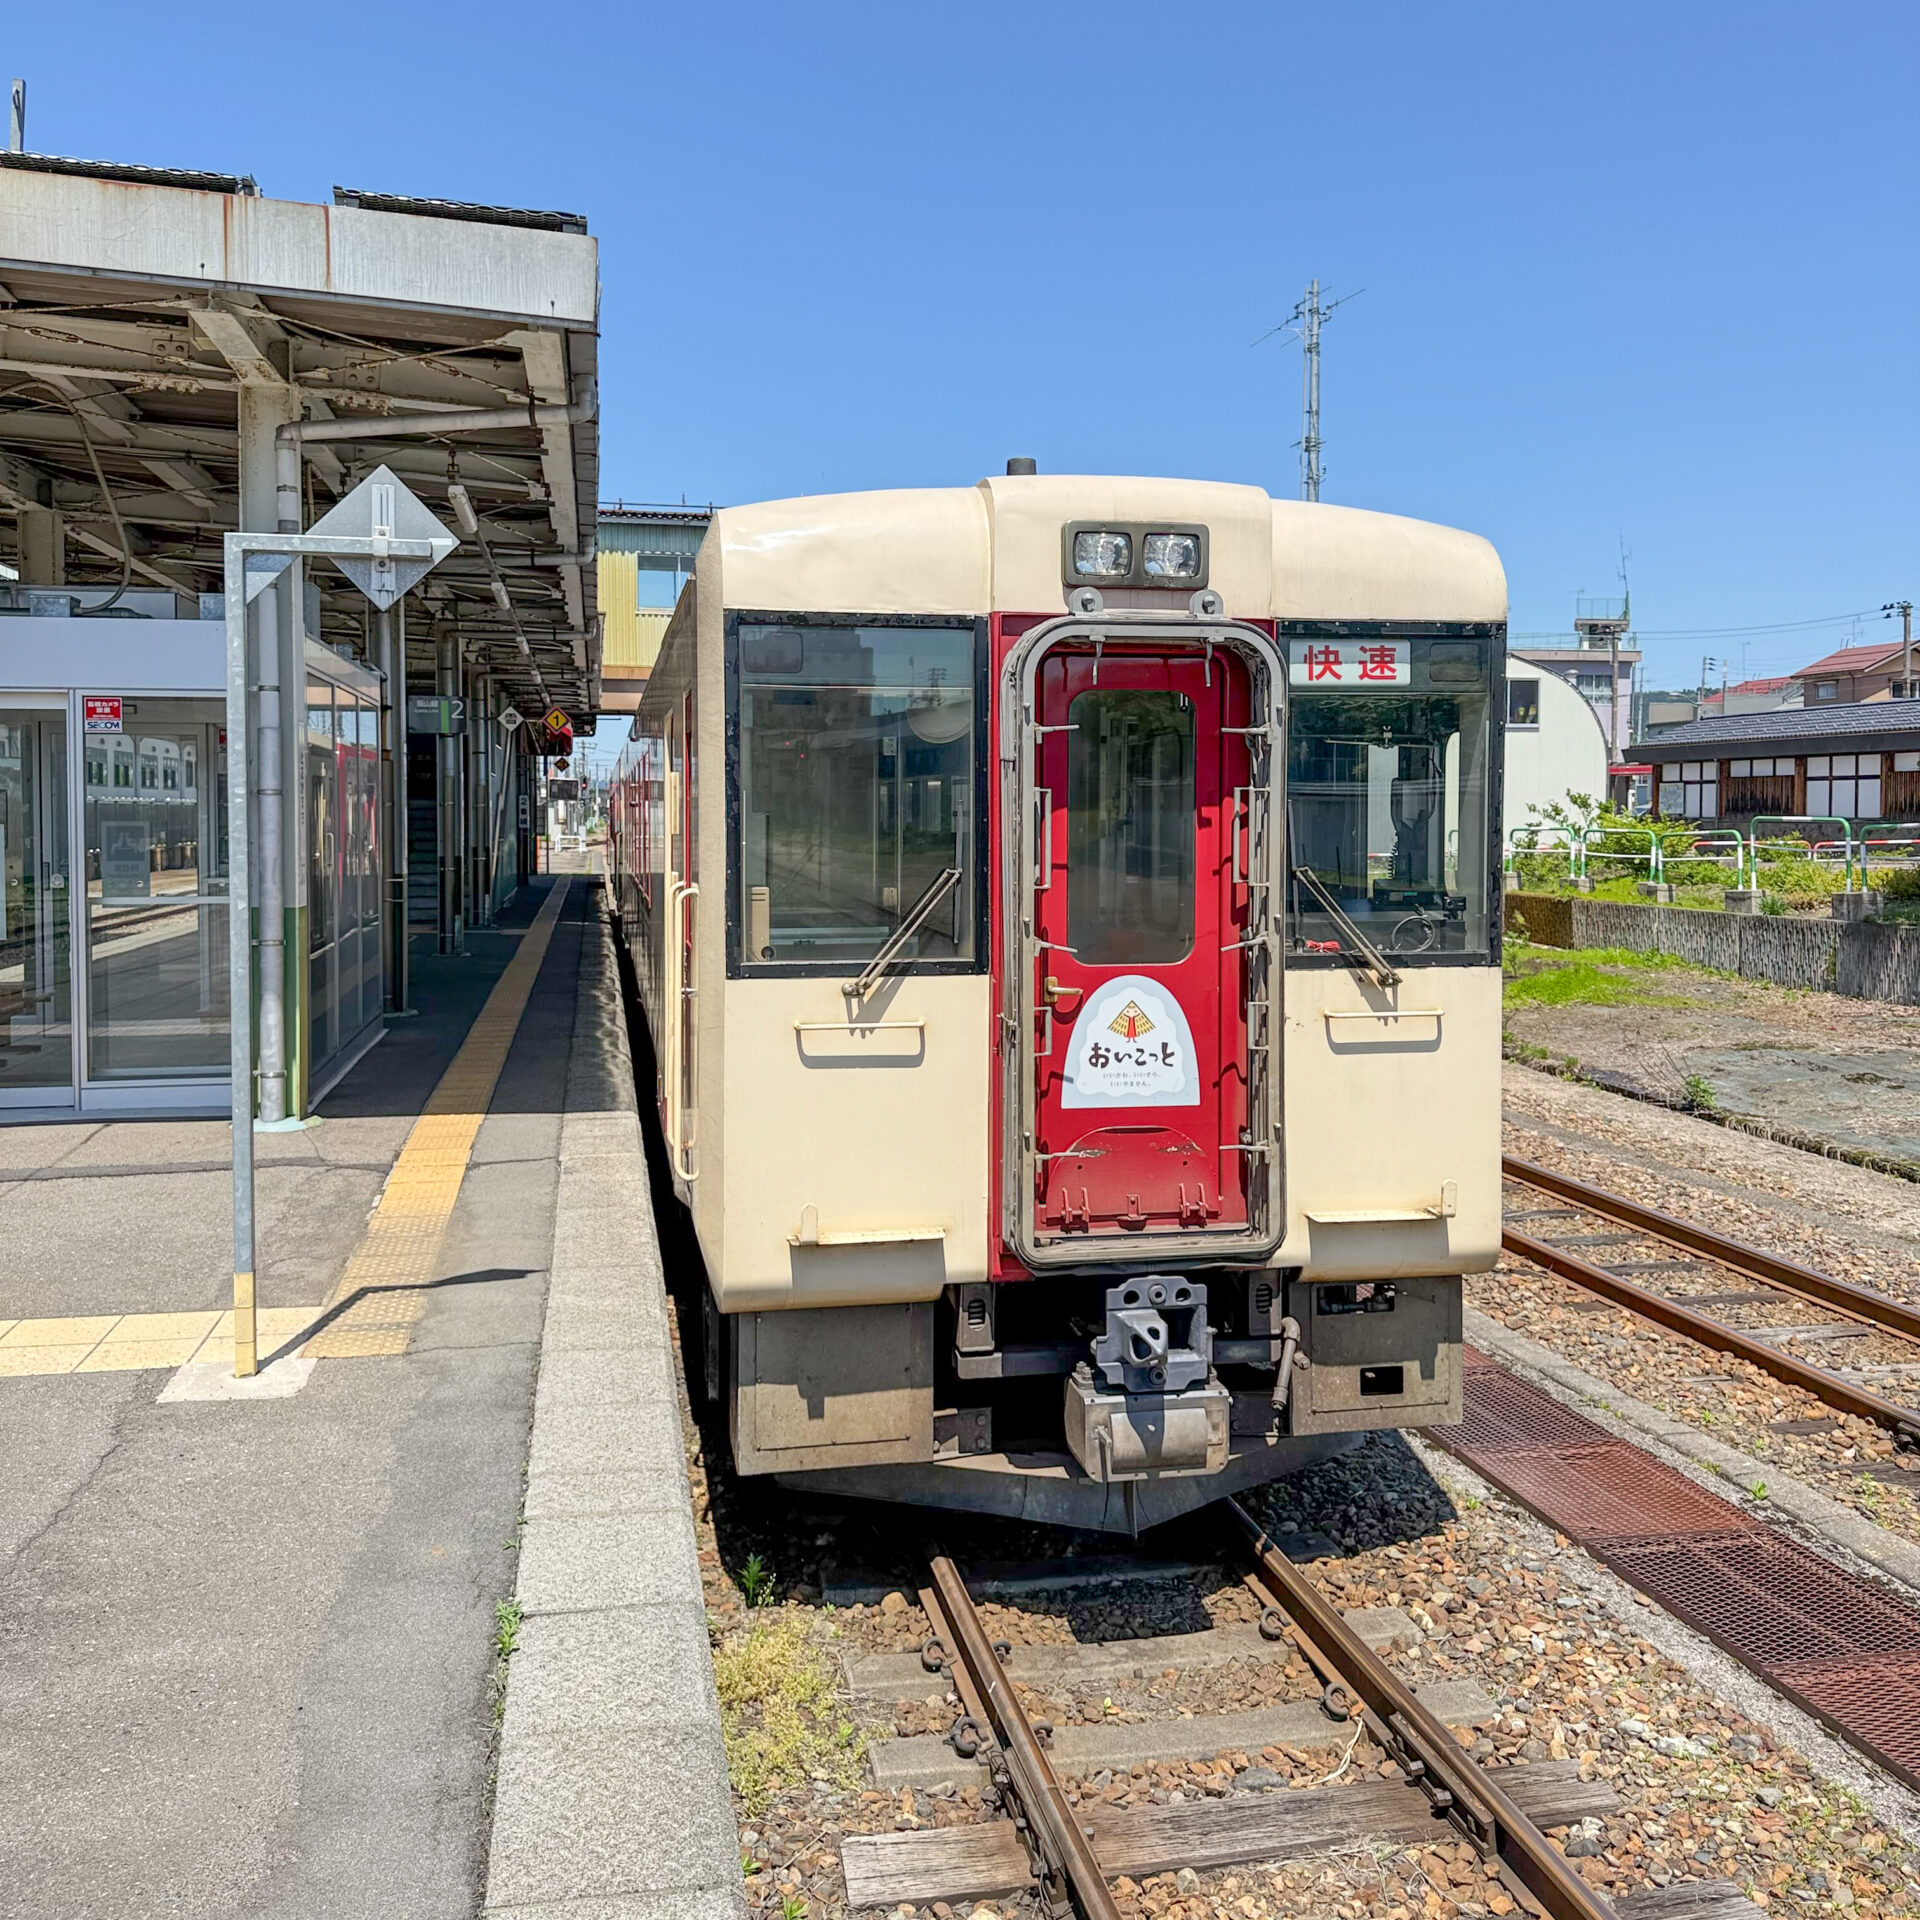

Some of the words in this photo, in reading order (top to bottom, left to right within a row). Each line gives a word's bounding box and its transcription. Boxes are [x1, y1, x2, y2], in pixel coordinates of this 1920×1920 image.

[1303, 644, 1397, 681] 快速
[451, 700, 465, 719] 2
[87, 721, 120, 729] SECOM
[553, 714, 559, 727] 1
[1088, 1042, 1175, 1069] おいこっと
